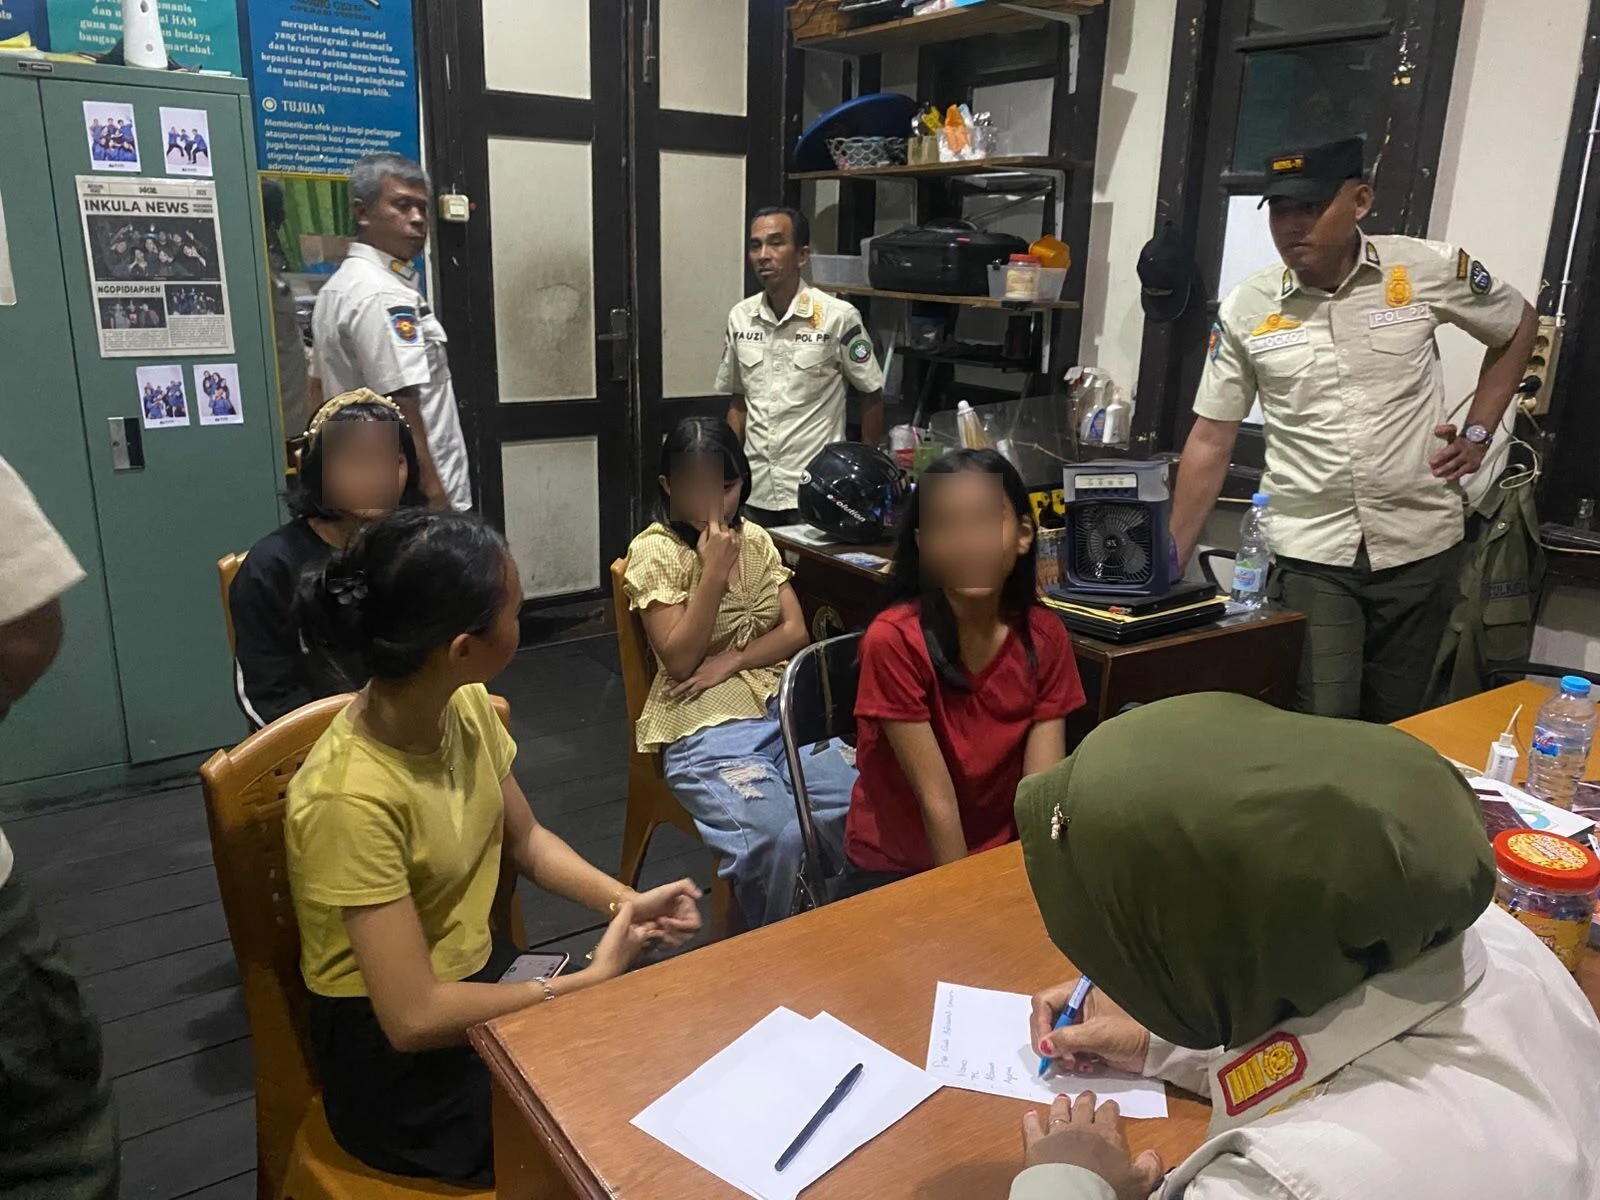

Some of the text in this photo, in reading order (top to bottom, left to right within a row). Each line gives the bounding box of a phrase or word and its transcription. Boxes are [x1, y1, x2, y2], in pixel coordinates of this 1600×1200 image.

[92, 8, 112, 18] dan
[172, 13, 196, 26] HAM
[80, 19, 106, 30] guna
[174, 29, 211, 43] budaya
[275, 31, 296, 42] yang
[281, 20, 387, 40] merupakan sebuah model
[79, 32, 214, 55] bangsa martabat.
[268, 41, 285, 51] dan
[322, 47, 348, 58] dalam
[350, 52, 400, 64] memberikan
[261, 52, 303, 64] kepastian
[305, 57, 321, 67] dan
[323, 60, 377, 74] perlindungan
[266, 65, 405, 88] dan mendorong pada peningkatan
[283, 78, 318, 90] kualitas
[320, 81, 361, 94] pelayanan
[281, 100, 326, 114] TUJUAN
[264, 118, 314, 130] Memberikan
[315, 122, 331, 131] efek
[331, 124, 346, 134] jera
[347, 125, 364, 135] bagi
[265, 130, 298, 141] ataupun
[300, 133, 327, 143] pemilik
[266, 141, 283, 151] juga
[84, 199, 141, 213] INKULA
[145, 201, 189, 214] NEWS
[1373, 304, 1427, 325] POL PP
[795, 332, 830, 343] POL PP
